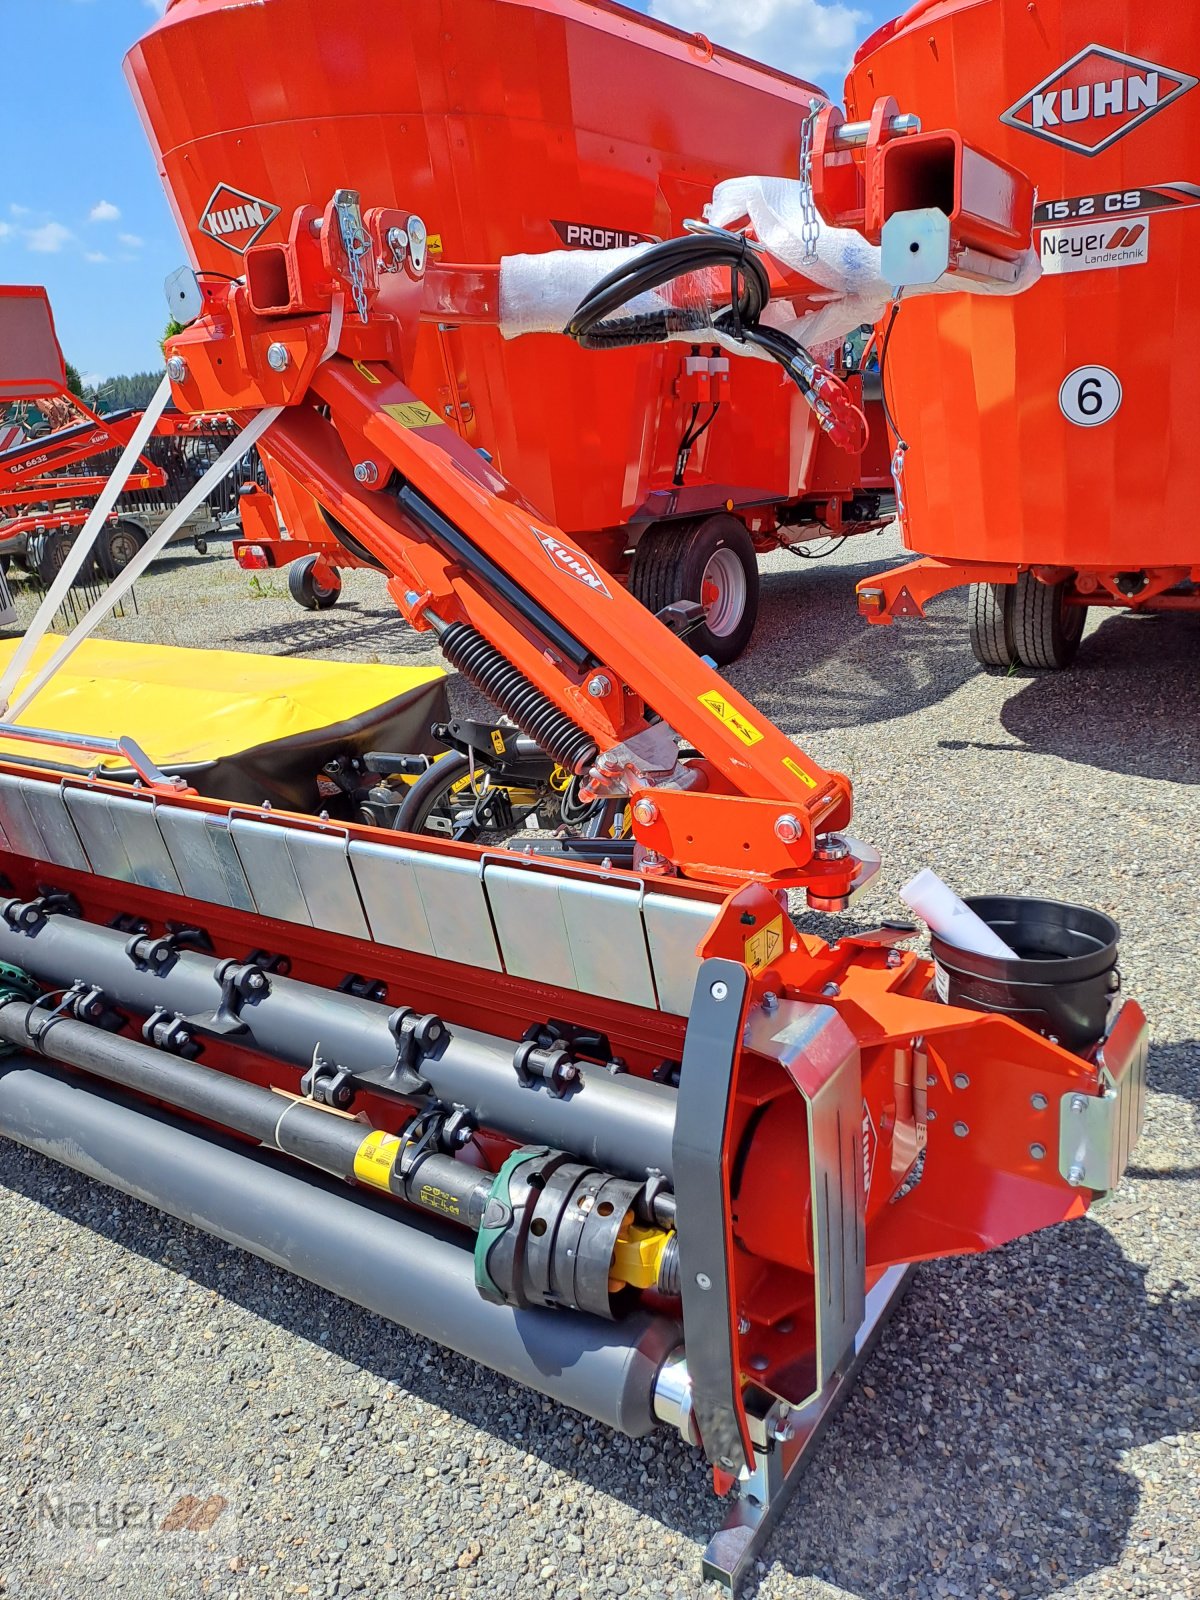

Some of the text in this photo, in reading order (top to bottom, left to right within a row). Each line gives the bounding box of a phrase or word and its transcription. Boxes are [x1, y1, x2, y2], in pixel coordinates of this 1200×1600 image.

[1032, 72, 1158, 128] KUHN
[206, 202, 264, 236] KUHN
[1045, 191, 1141, 220] 15.2 CS
[1043, 233, 1105, 257] Neyer
[1084, 248, 1144, 264] Landtechnik
[1077, 377, 1103, 416] 6
[10, 454, 48, 474] GA 6632
[540, 537, 602, 588] KUHN
